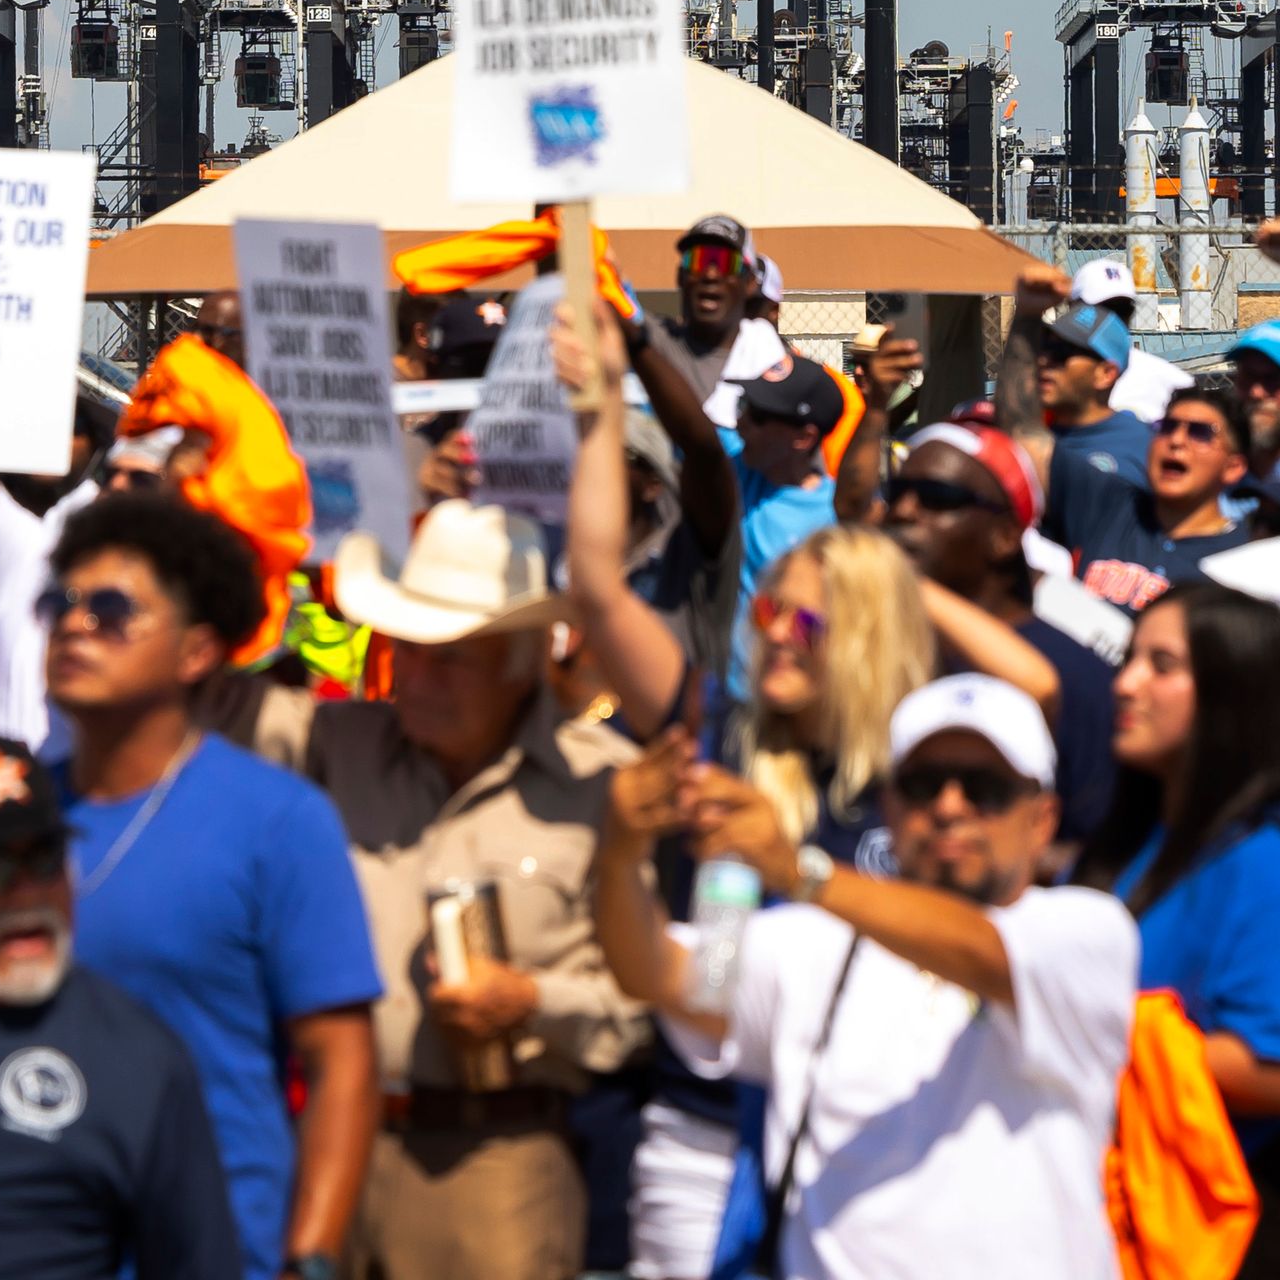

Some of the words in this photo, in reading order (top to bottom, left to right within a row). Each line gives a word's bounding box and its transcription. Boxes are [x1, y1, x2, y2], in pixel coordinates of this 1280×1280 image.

[309, 8, 329, 19] 128
[1098, 26, 1117, 36] 180
[527, 31, 660, 71] SECURITY
[14, 220, 64, 246] OUR
